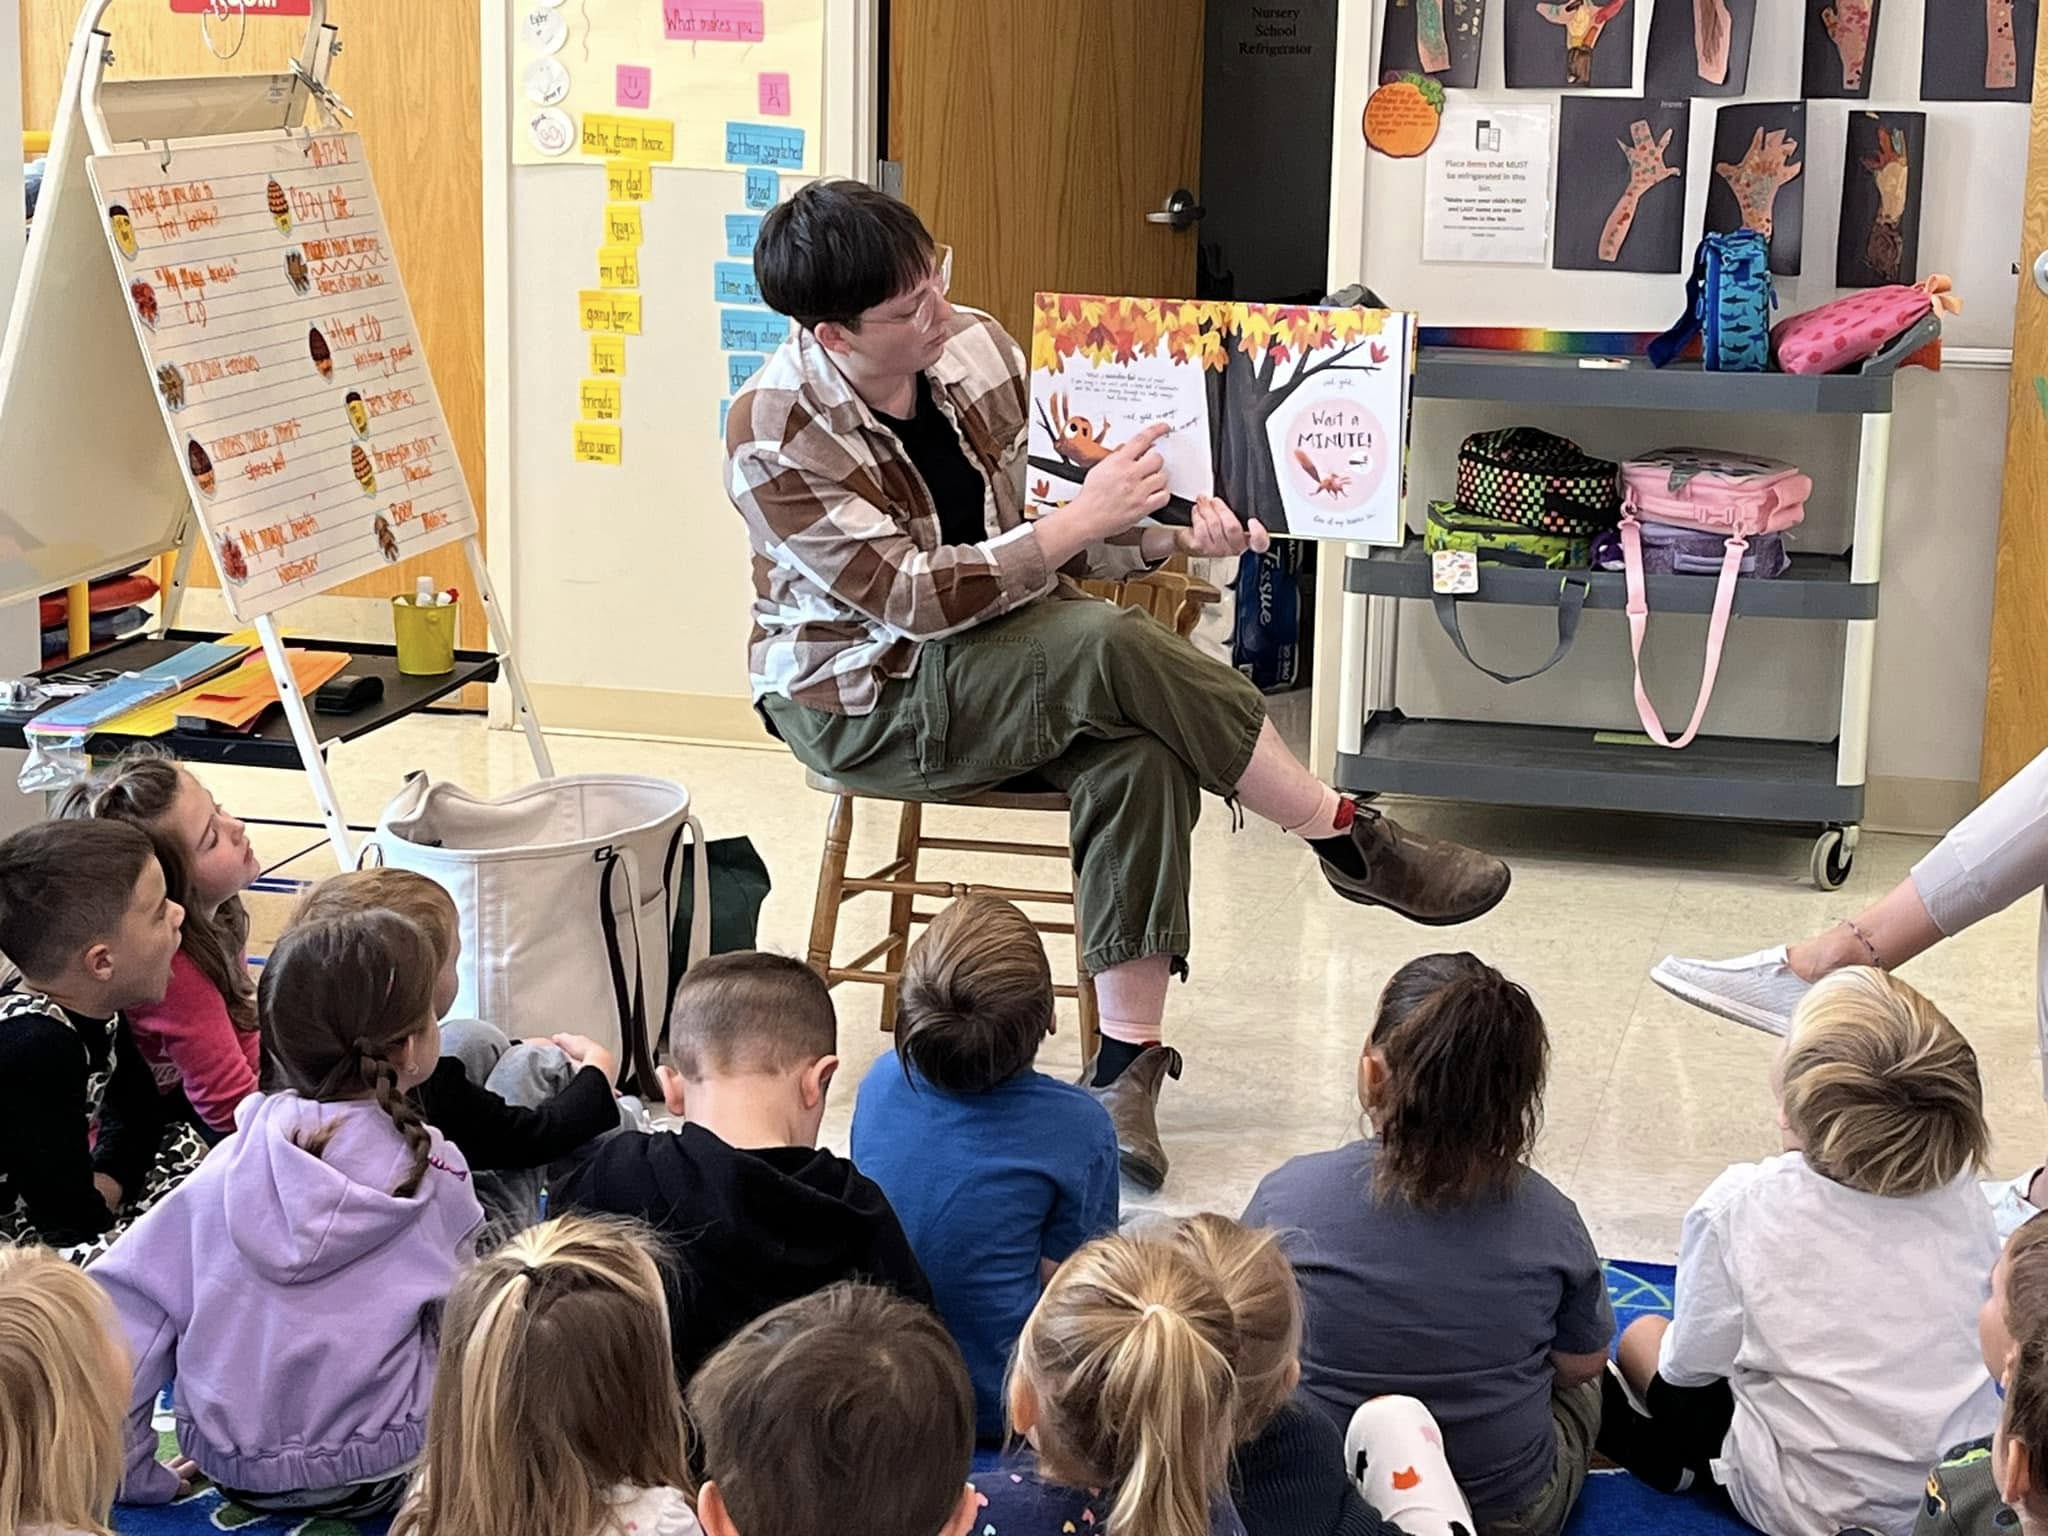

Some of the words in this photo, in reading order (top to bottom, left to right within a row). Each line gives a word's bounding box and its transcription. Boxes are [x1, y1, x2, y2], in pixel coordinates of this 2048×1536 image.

[664, 8, 696, 32] What
[1251, 7, 1300, 21] Nursery
[1255, 23, 1297, 37] School
[1239, 42, 1312, 57] Refrigerator
[626, 168, 642, 191] dad
[581, 386, 612, 409] friends
[1312, 410, 1343, 427] Wait
[1351, 415, 1359, 426] a
[1298, 432, 1372, 448] MINUTE!
[1259, 546, 1281, 626] Tissue
